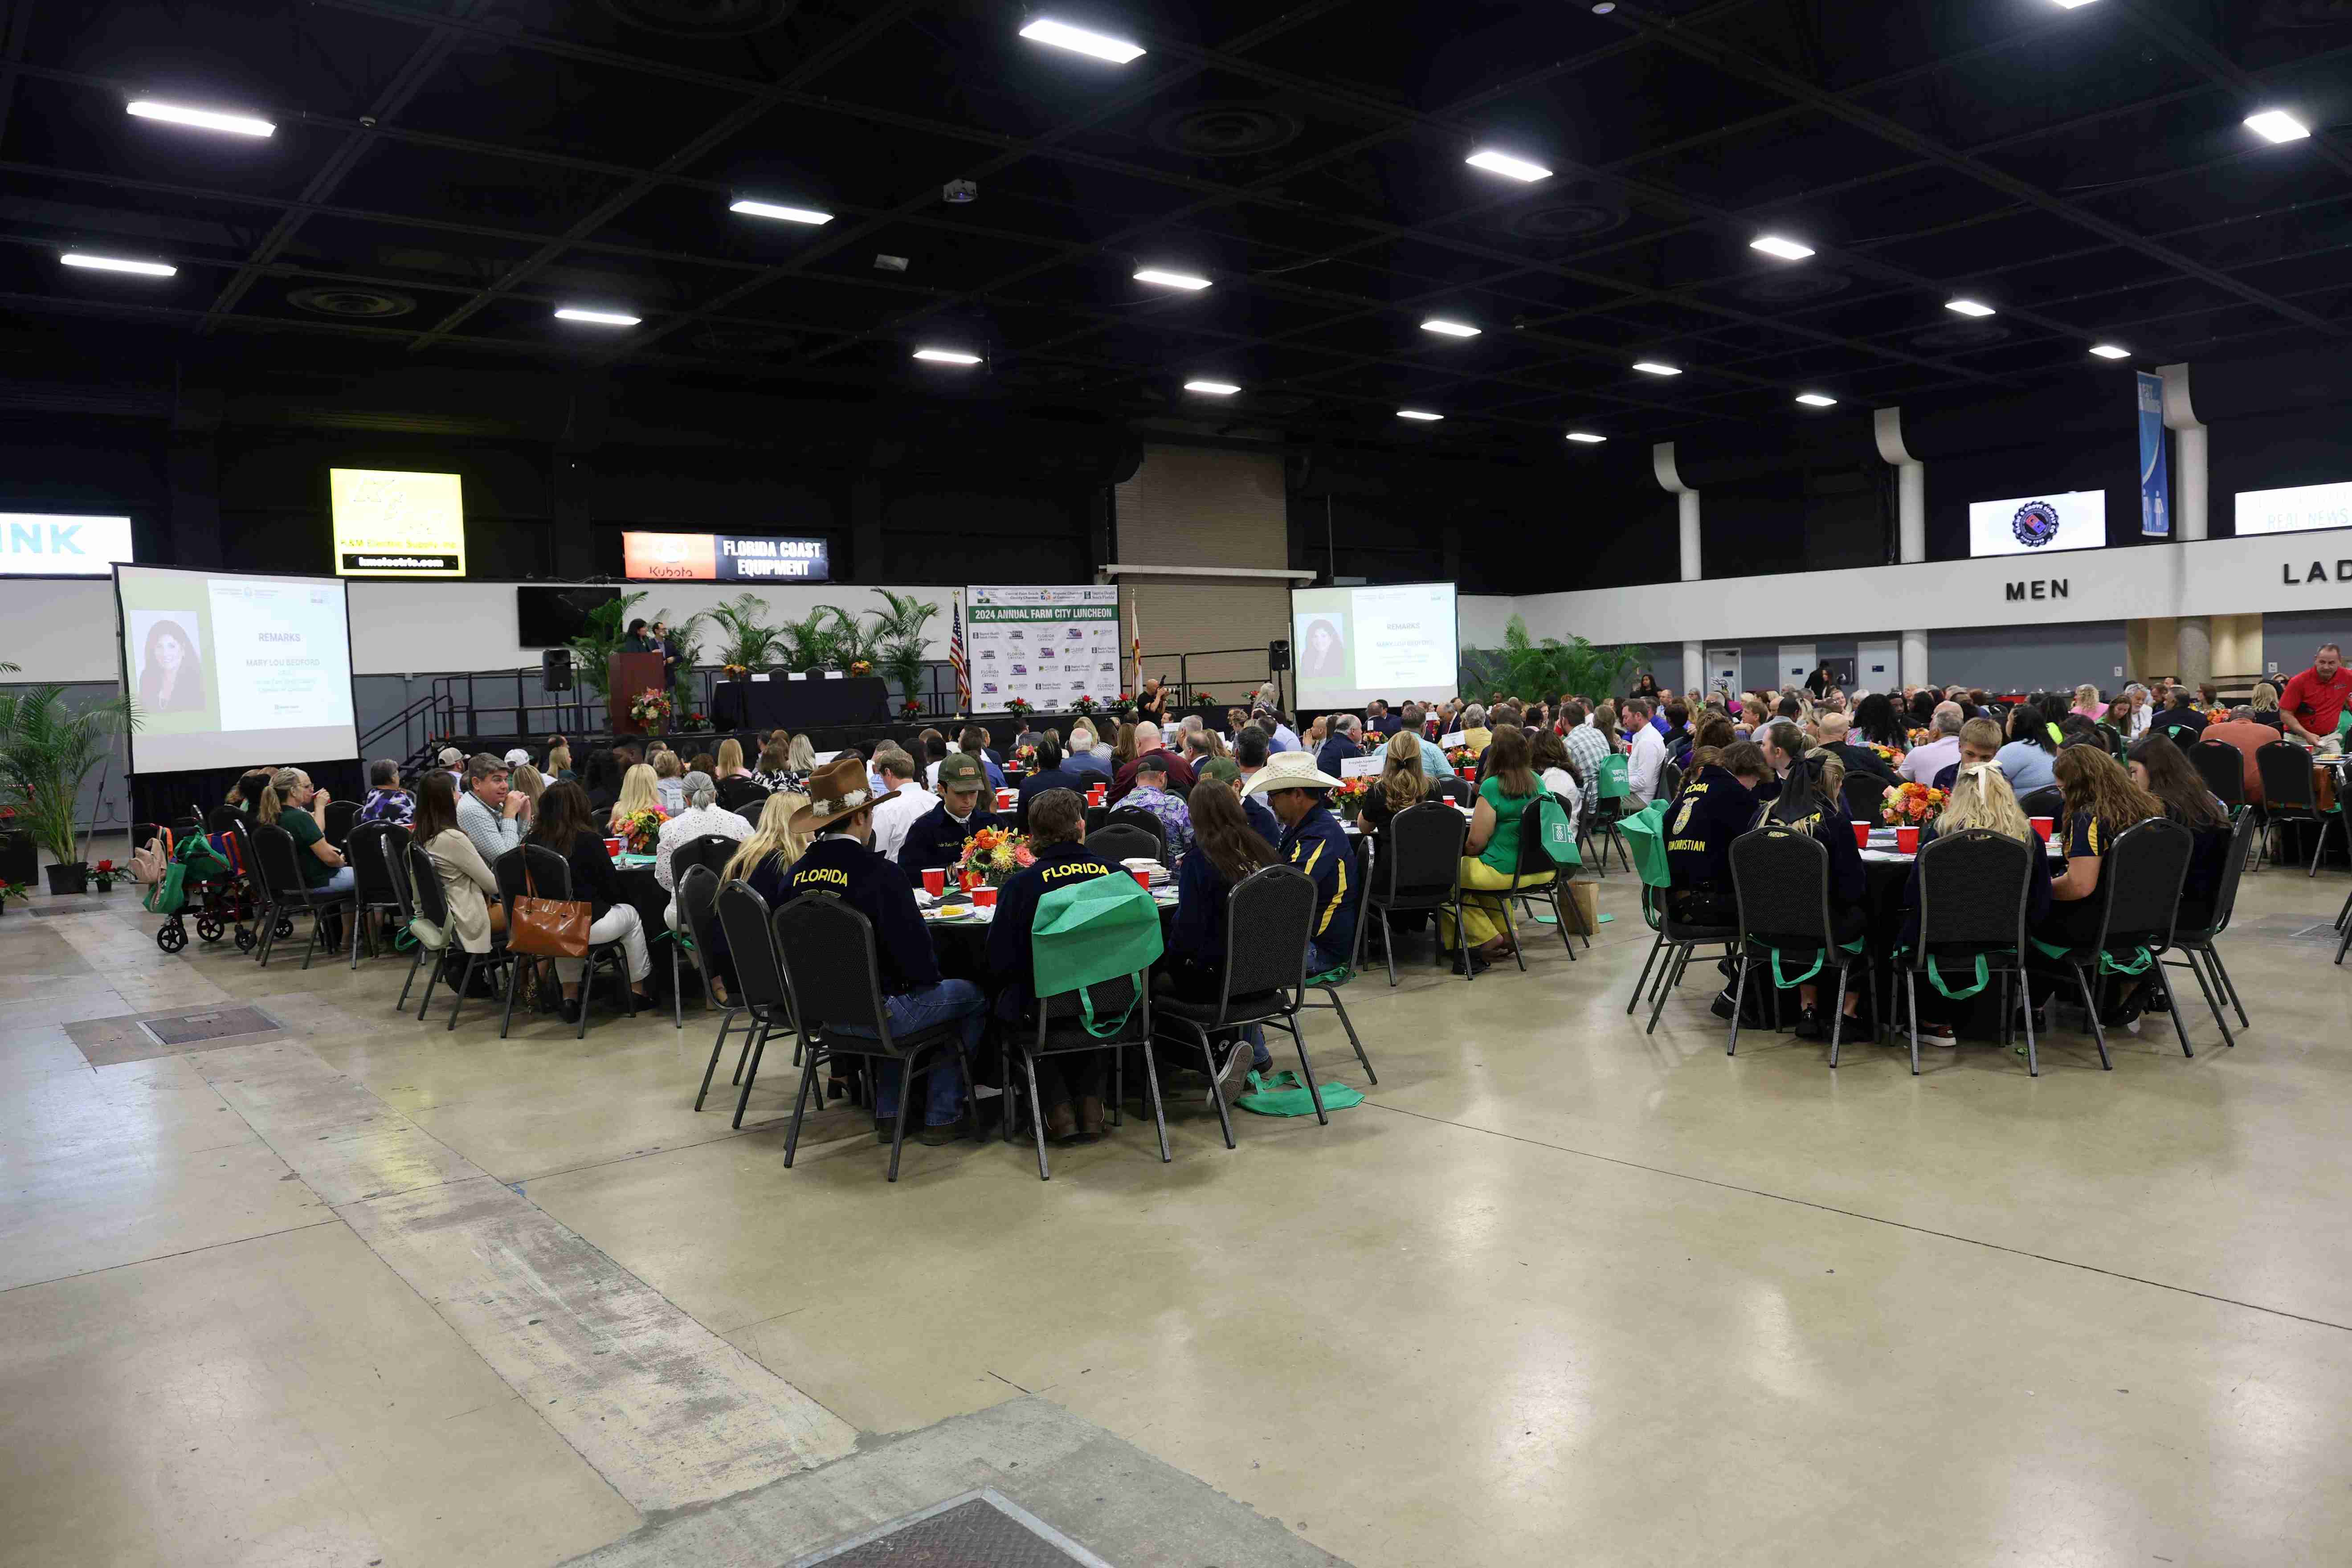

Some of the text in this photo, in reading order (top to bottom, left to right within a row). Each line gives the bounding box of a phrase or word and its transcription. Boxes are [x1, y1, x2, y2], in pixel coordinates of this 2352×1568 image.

[2043, 506, 2057, 524] SUPPLY
[0, 522, 86, 555] NK
[723, 540, 821, 558] FLORIDA COAST
[649, 567, 693, 577] Kubota
[737, 559, 810, 577] EQUIPMENT
[2006, 579, 2068, 600] MEN
[976, 608, 1112, 619] 2024 ANNUAL FARM CITY LUNCHEON
[258, 633, 301, 642] REMARKS
[793, 869, 848, 887] FLORIDA
[1042, 863, 1110, 882] FLORIDA
